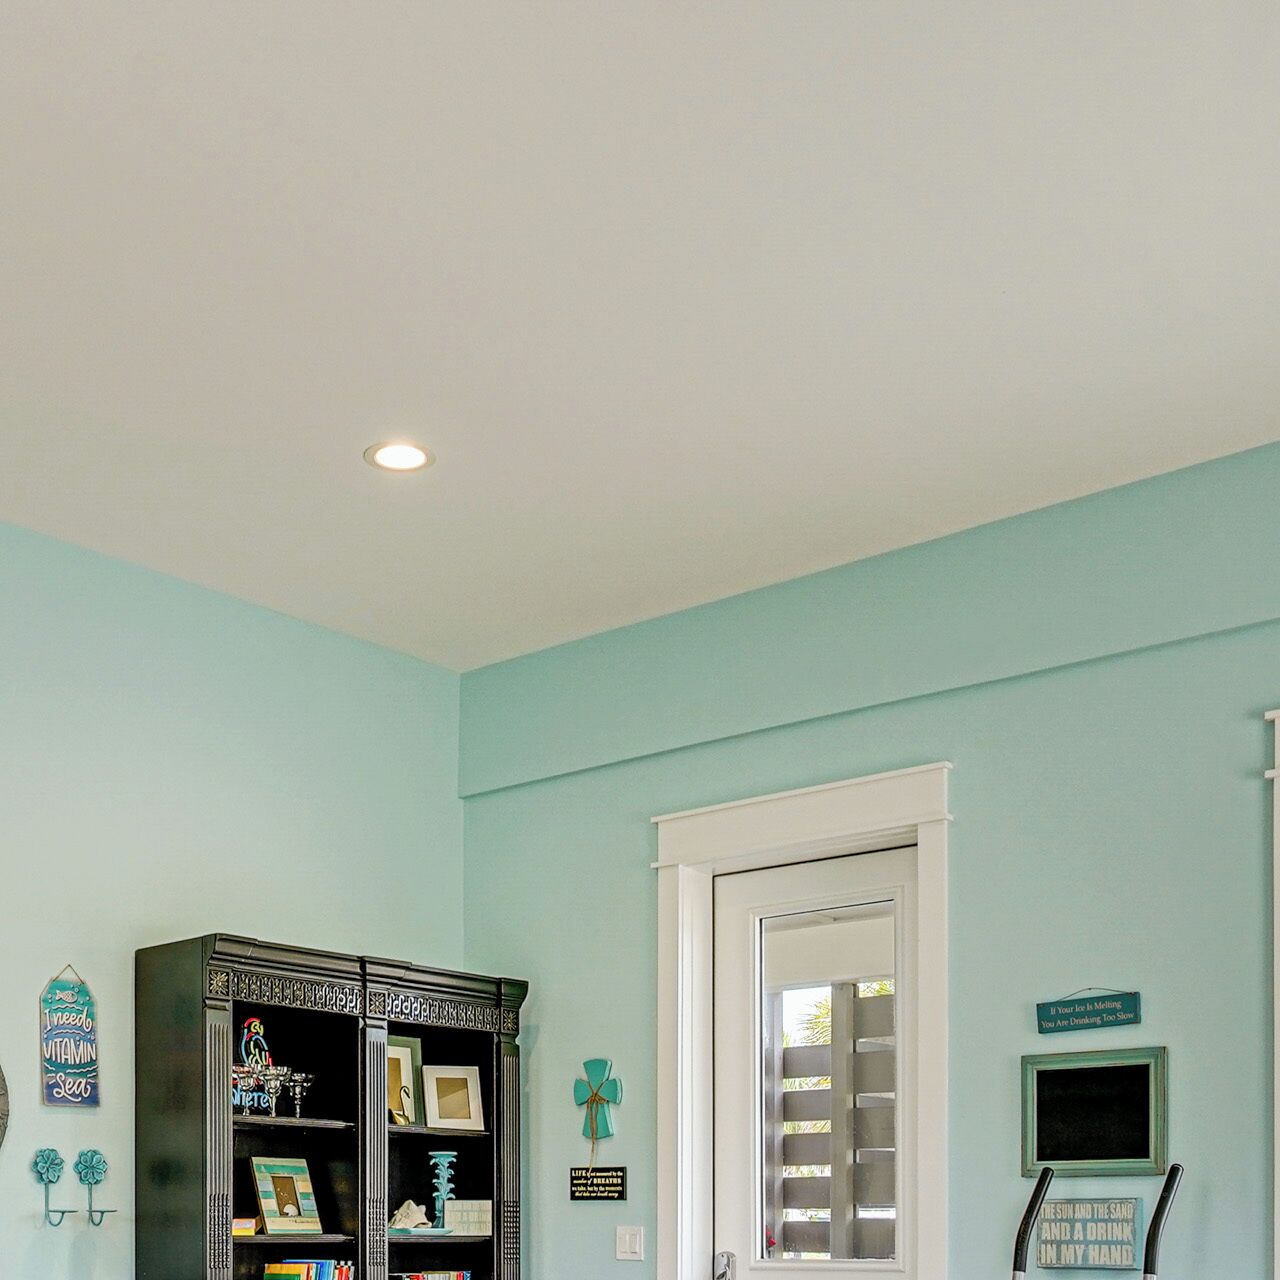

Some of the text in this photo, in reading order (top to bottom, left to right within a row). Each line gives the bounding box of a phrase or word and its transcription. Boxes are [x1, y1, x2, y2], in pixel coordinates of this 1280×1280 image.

[1050, 1007, 1056, 1015] If
[1057, 1006, 1074, 1014] Your
[1075, 1004, 1085, 1012] Ice
[1094, 1000, 1122, 1009] Melting
[44, 1006, 93, 1033] I need
[1041, 1011, 1135, 1029] You Are Drinking Too Slow
[43, 1037, 96, 1065] VITAMIN
[53, 1072, 92, 1102] Sea
[1040, 1202, 1134, 1219] THE SUN AND THE SAND
[1041, 1222, 1133, 1241] AND A DRINK
[1040, 1243, 1134, 1265] IN MY HAND
